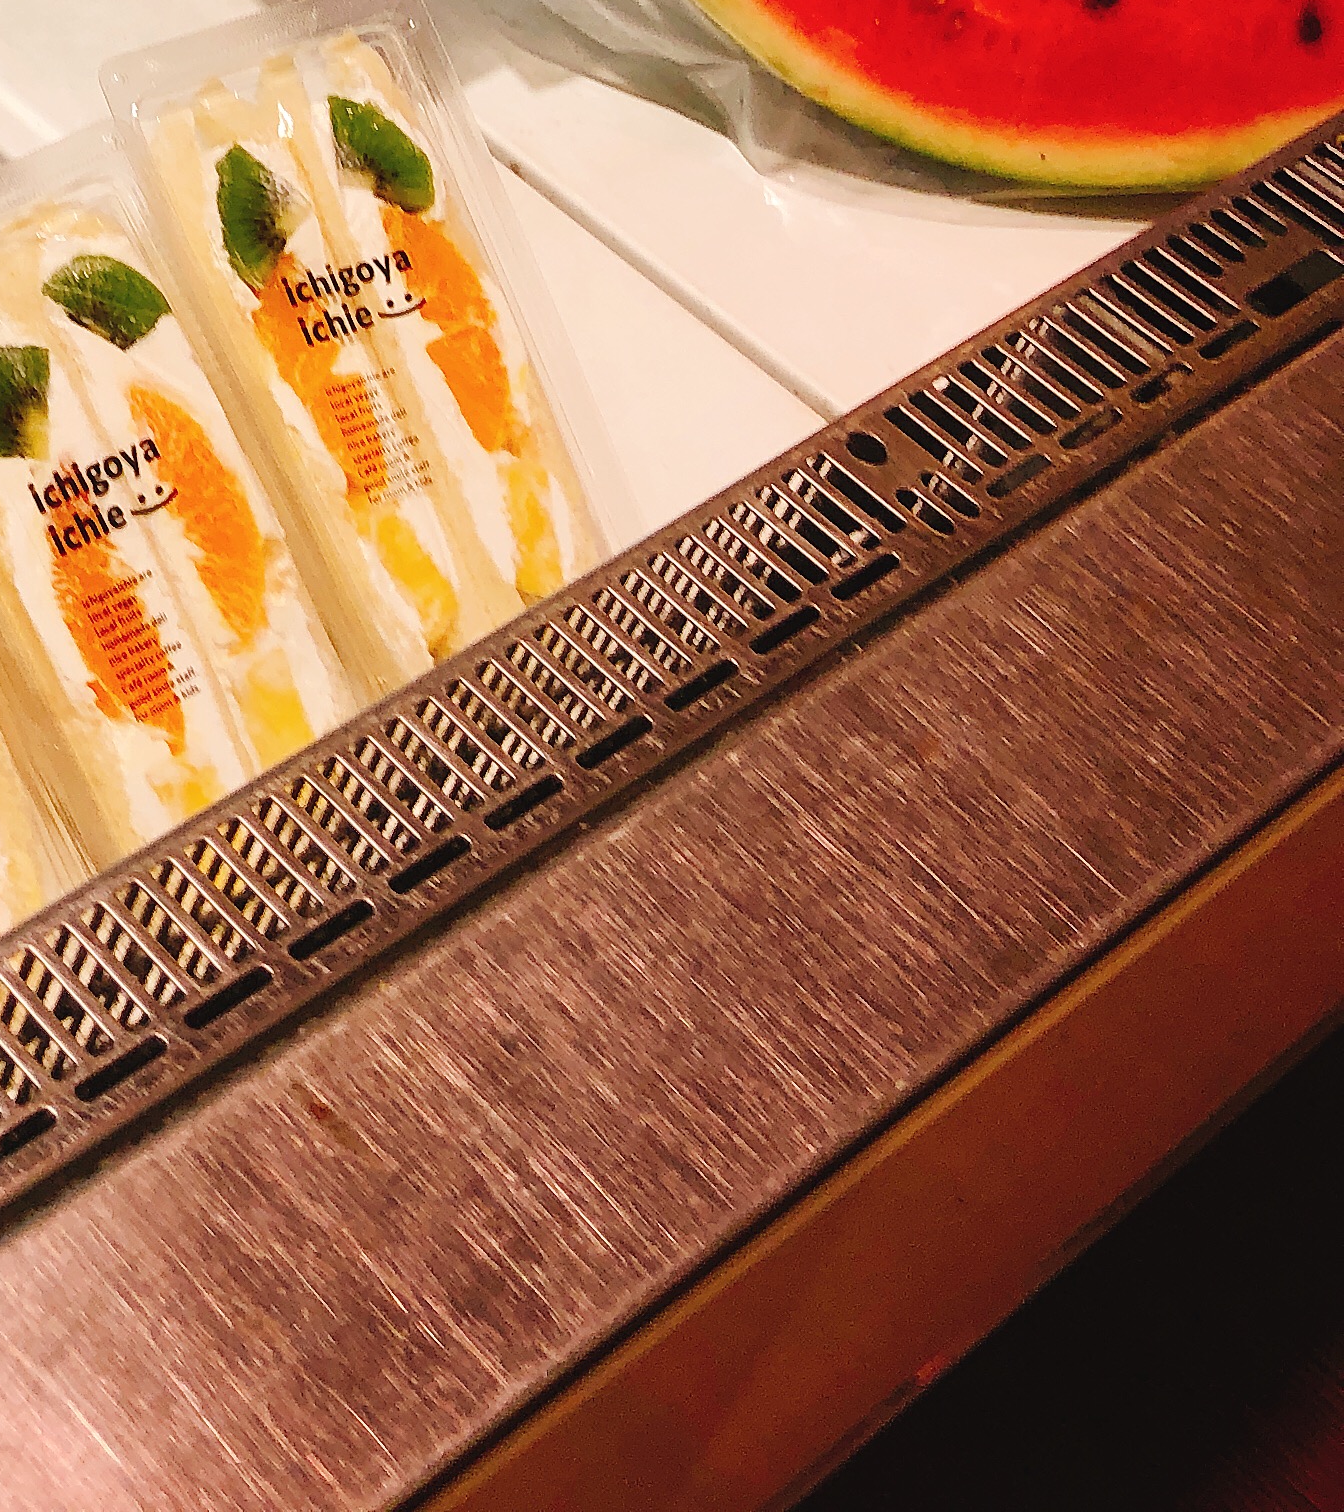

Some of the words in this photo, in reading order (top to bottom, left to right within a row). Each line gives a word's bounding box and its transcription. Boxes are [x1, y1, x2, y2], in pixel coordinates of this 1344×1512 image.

[280, 245, 413, 309] ichigoya
[298, 303, 376, 348] ichie
[26, 434, 162, 515] ichigoya
[47, 501, 130, 558] ichie
